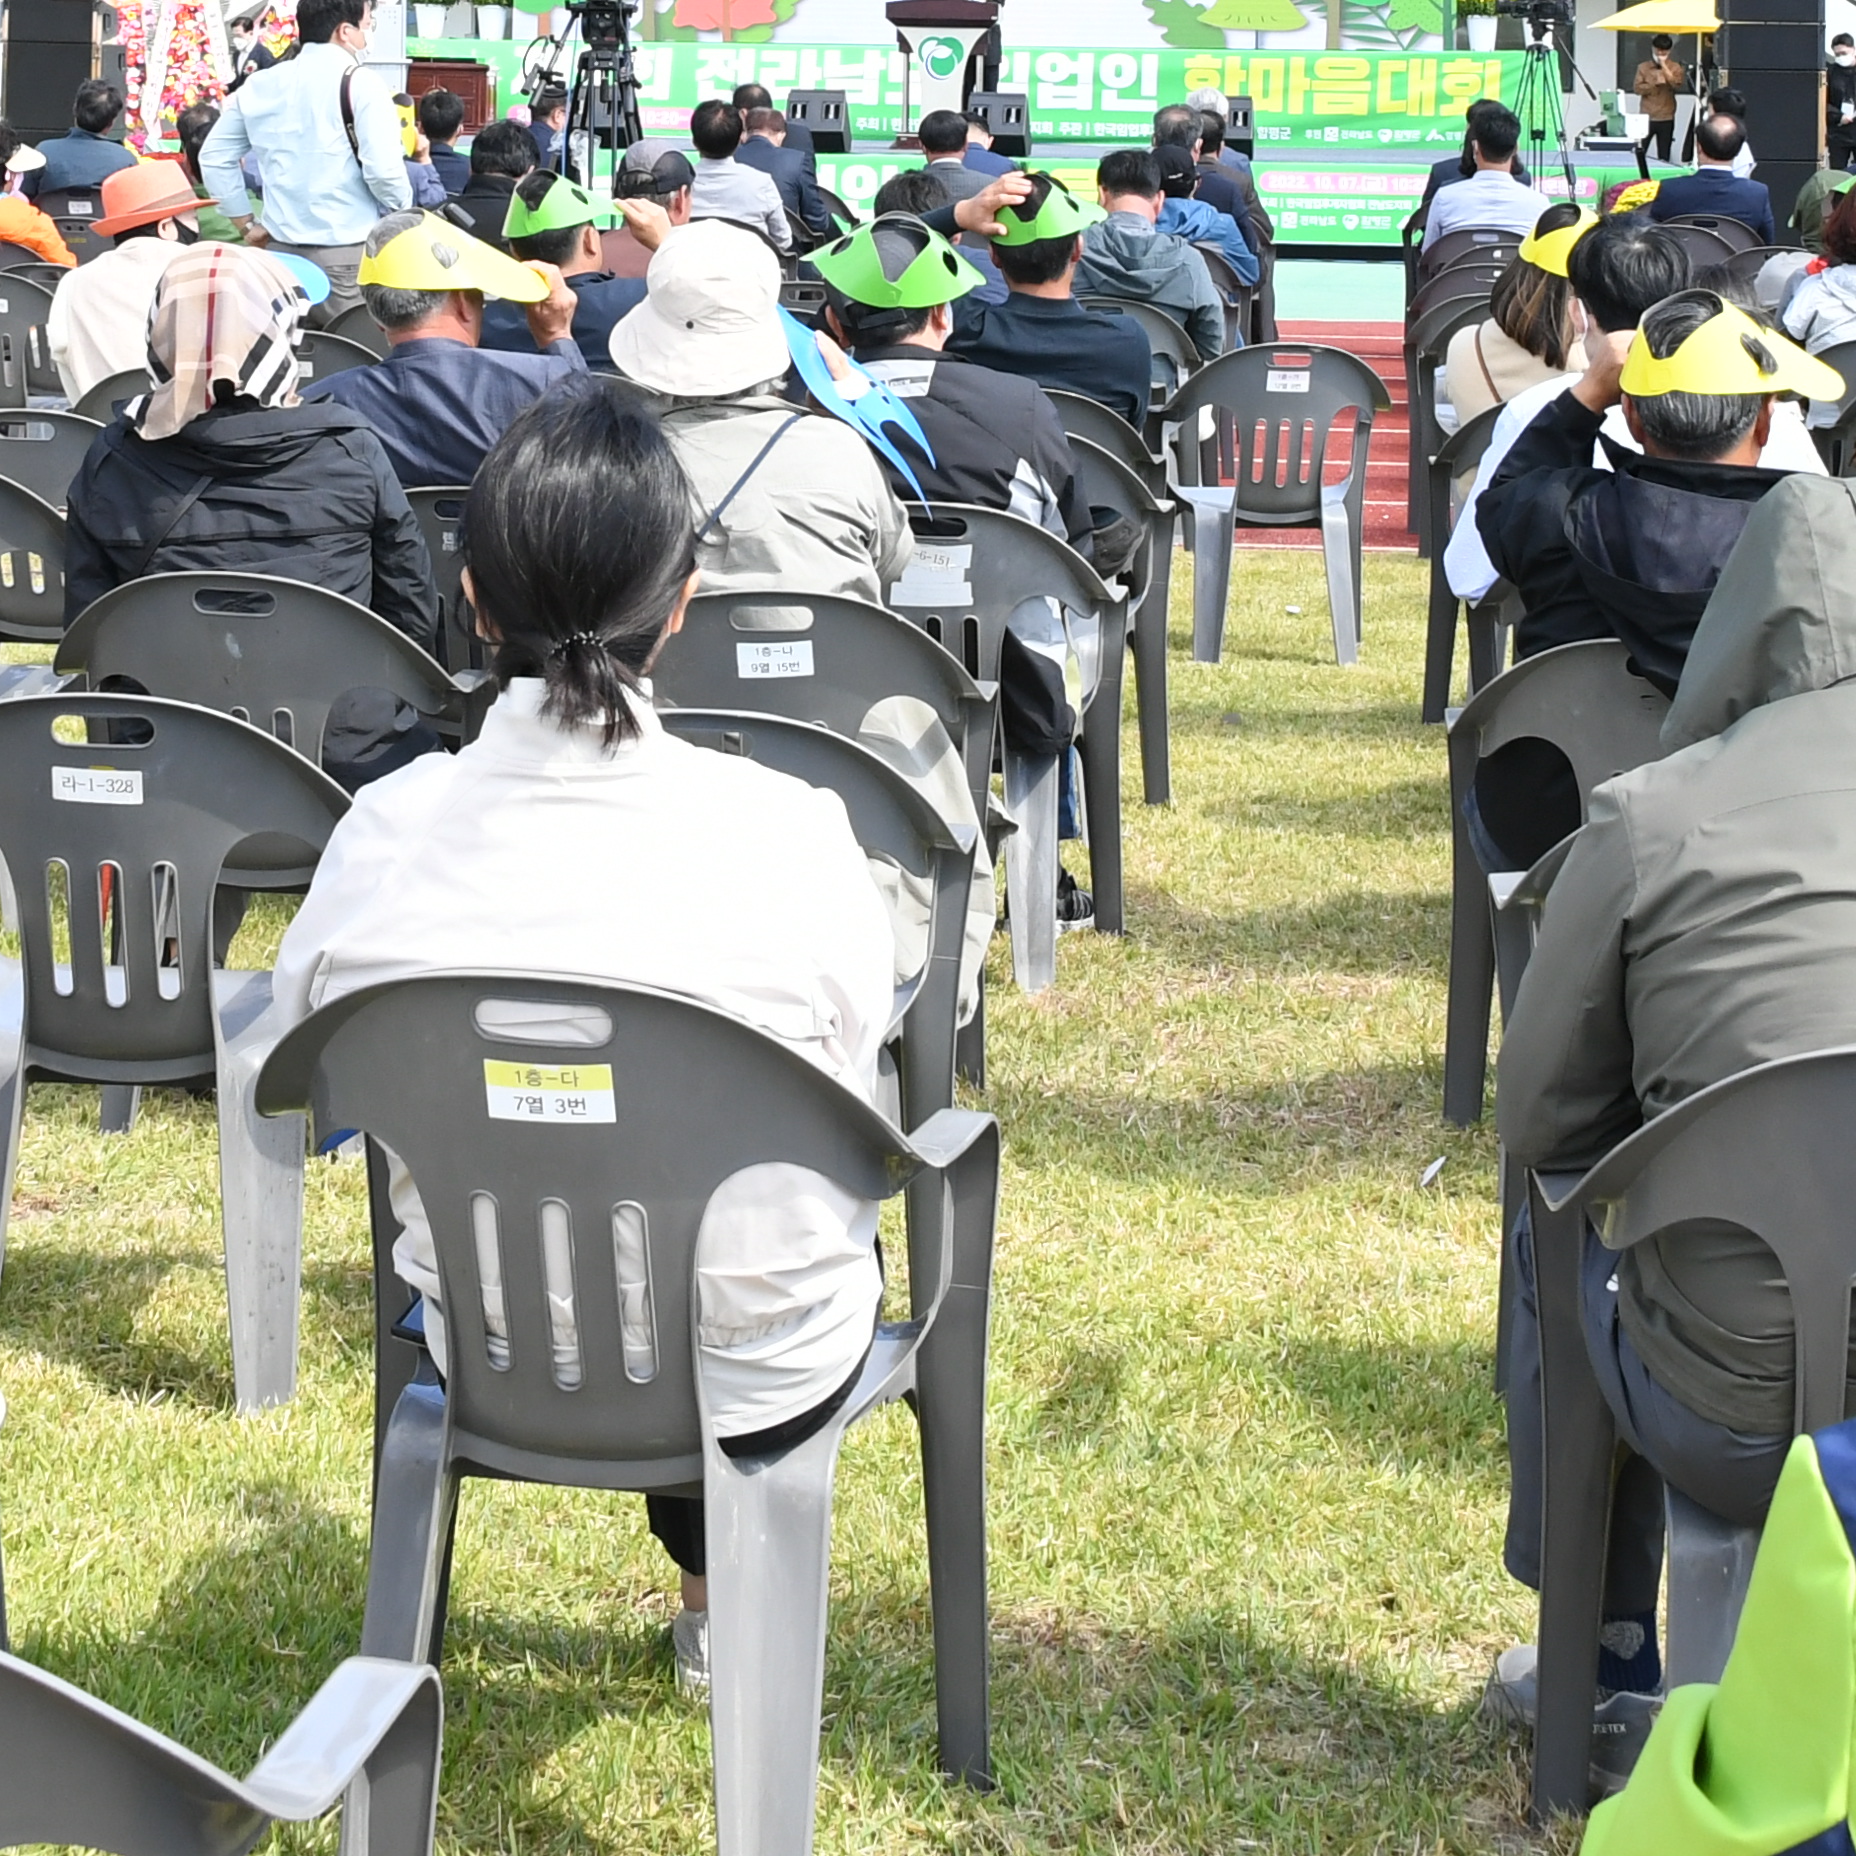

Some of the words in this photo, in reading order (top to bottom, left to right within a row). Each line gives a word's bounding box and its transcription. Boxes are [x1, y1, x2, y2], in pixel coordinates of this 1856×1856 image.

[510, 44, 673, 101] 제회
[1184, 53, 1502, 118] 한마음대회
[1059, 122, 1082, 136] 주관
[1093, 123, 1156, 137] 한국임업후
[914, 549, 951, 567] -6-151
[755, 645, 792, 657] 1층-나
[751, 662, 770, 674] 9열
[777, 661, 801, 673] 15번
[63, 776, 132, 794] 라-1-328
[514, 1068, 579, 1087] 1층-다
[513, 1095, 544, 1115] 7열
[555, 1097, 587, 1115] 3번
